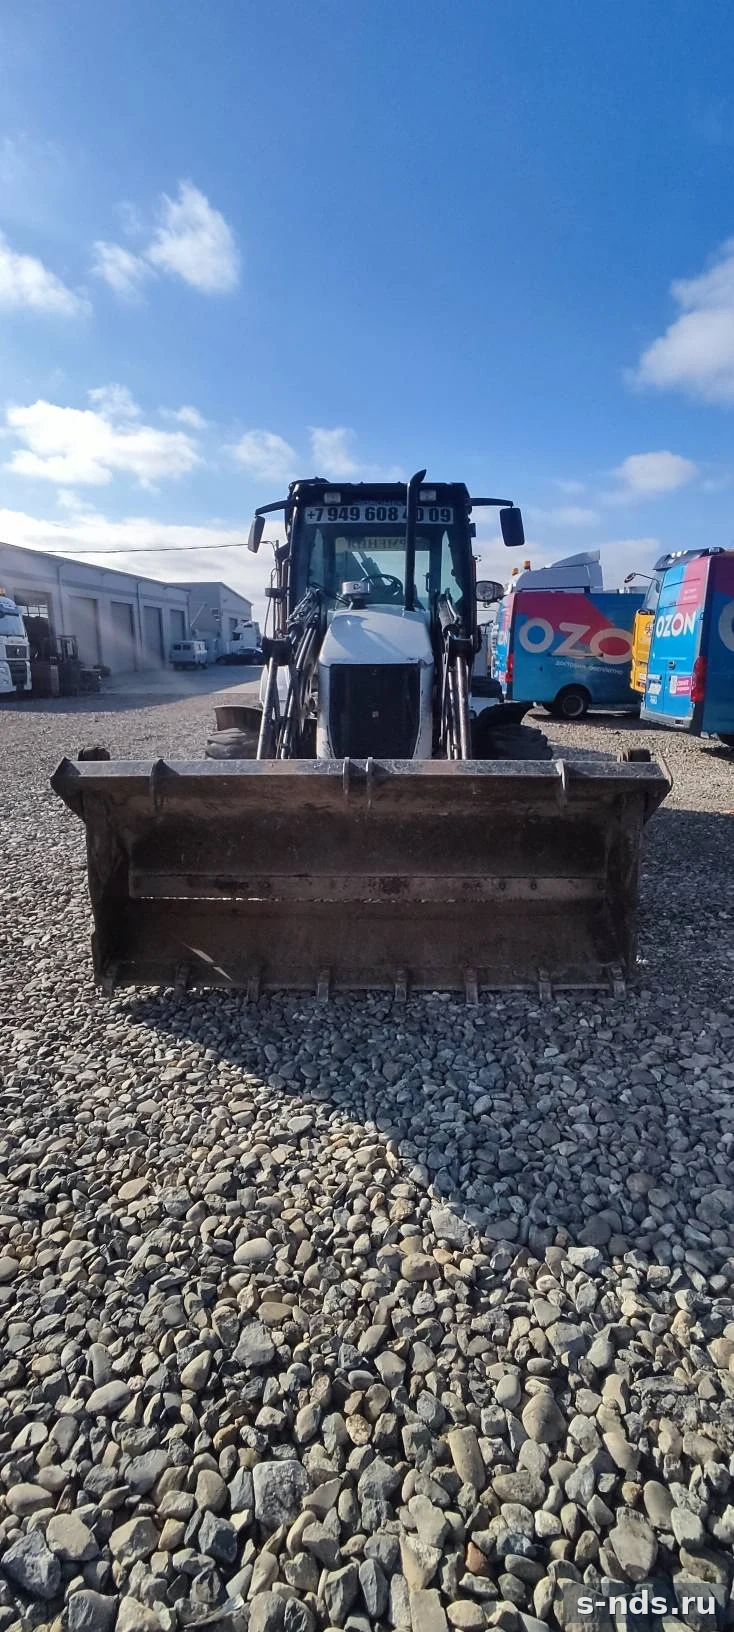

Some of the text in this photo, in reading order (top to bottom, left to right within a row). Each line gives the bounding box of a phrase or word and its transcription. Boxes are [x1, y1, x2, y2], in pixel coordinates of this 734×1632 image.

[307, 508, 324, 521] +7
[327, 507, 360, 521] 949
[364, 507, 398, 521] 608
[429, 508, 451, 522] 09
[656, 612, 697, 638] OZON
[519, 617, 633, 665] OZO
